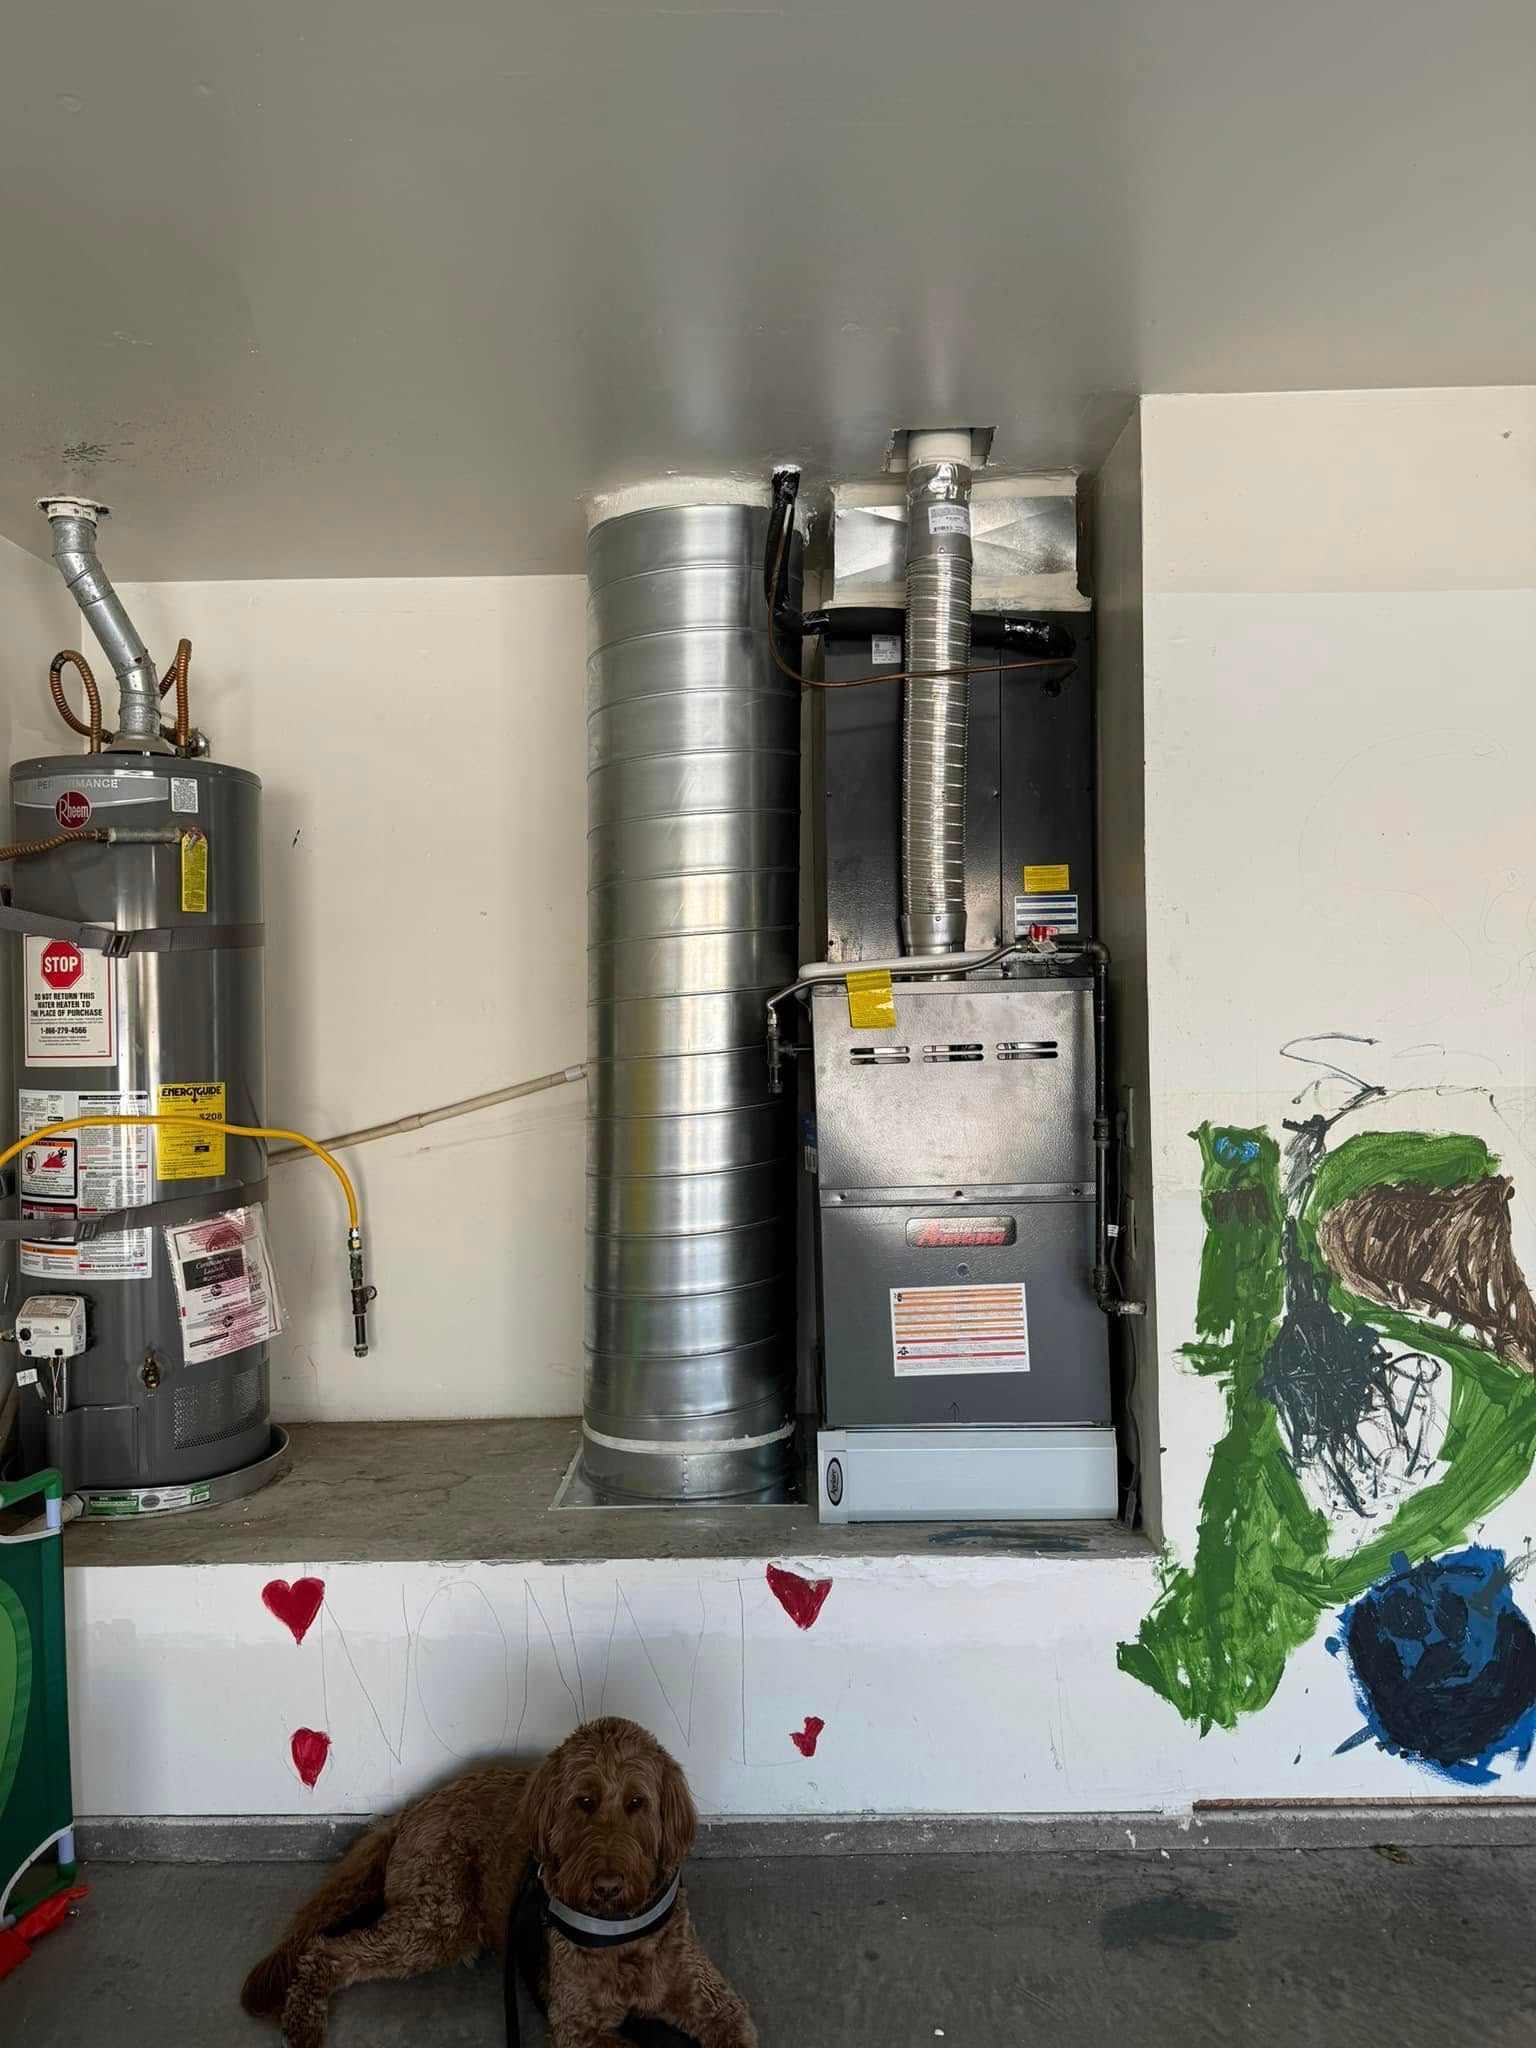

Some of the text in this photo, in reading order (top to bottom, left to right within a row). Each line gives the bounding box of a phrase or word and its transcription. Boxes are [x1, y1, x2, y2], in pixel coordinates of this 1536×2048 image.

[37, 779, 119, 790] PERRMANCE
[59, 792, 89, 823] Rheem
[44, 956, 79, 973] STOP
[53, 992, 78, 1000] RETURN
[79, 992, 95, 1000] THIS
[56, 1000, 80, 1008] HEATER
[81, 1000, 91, 1008] TO
[40, 1009, 56, 1017] PLACE
[57, 1009, 65, 1017] OF
[67, 1008, 103, 1017] PURCHASE
